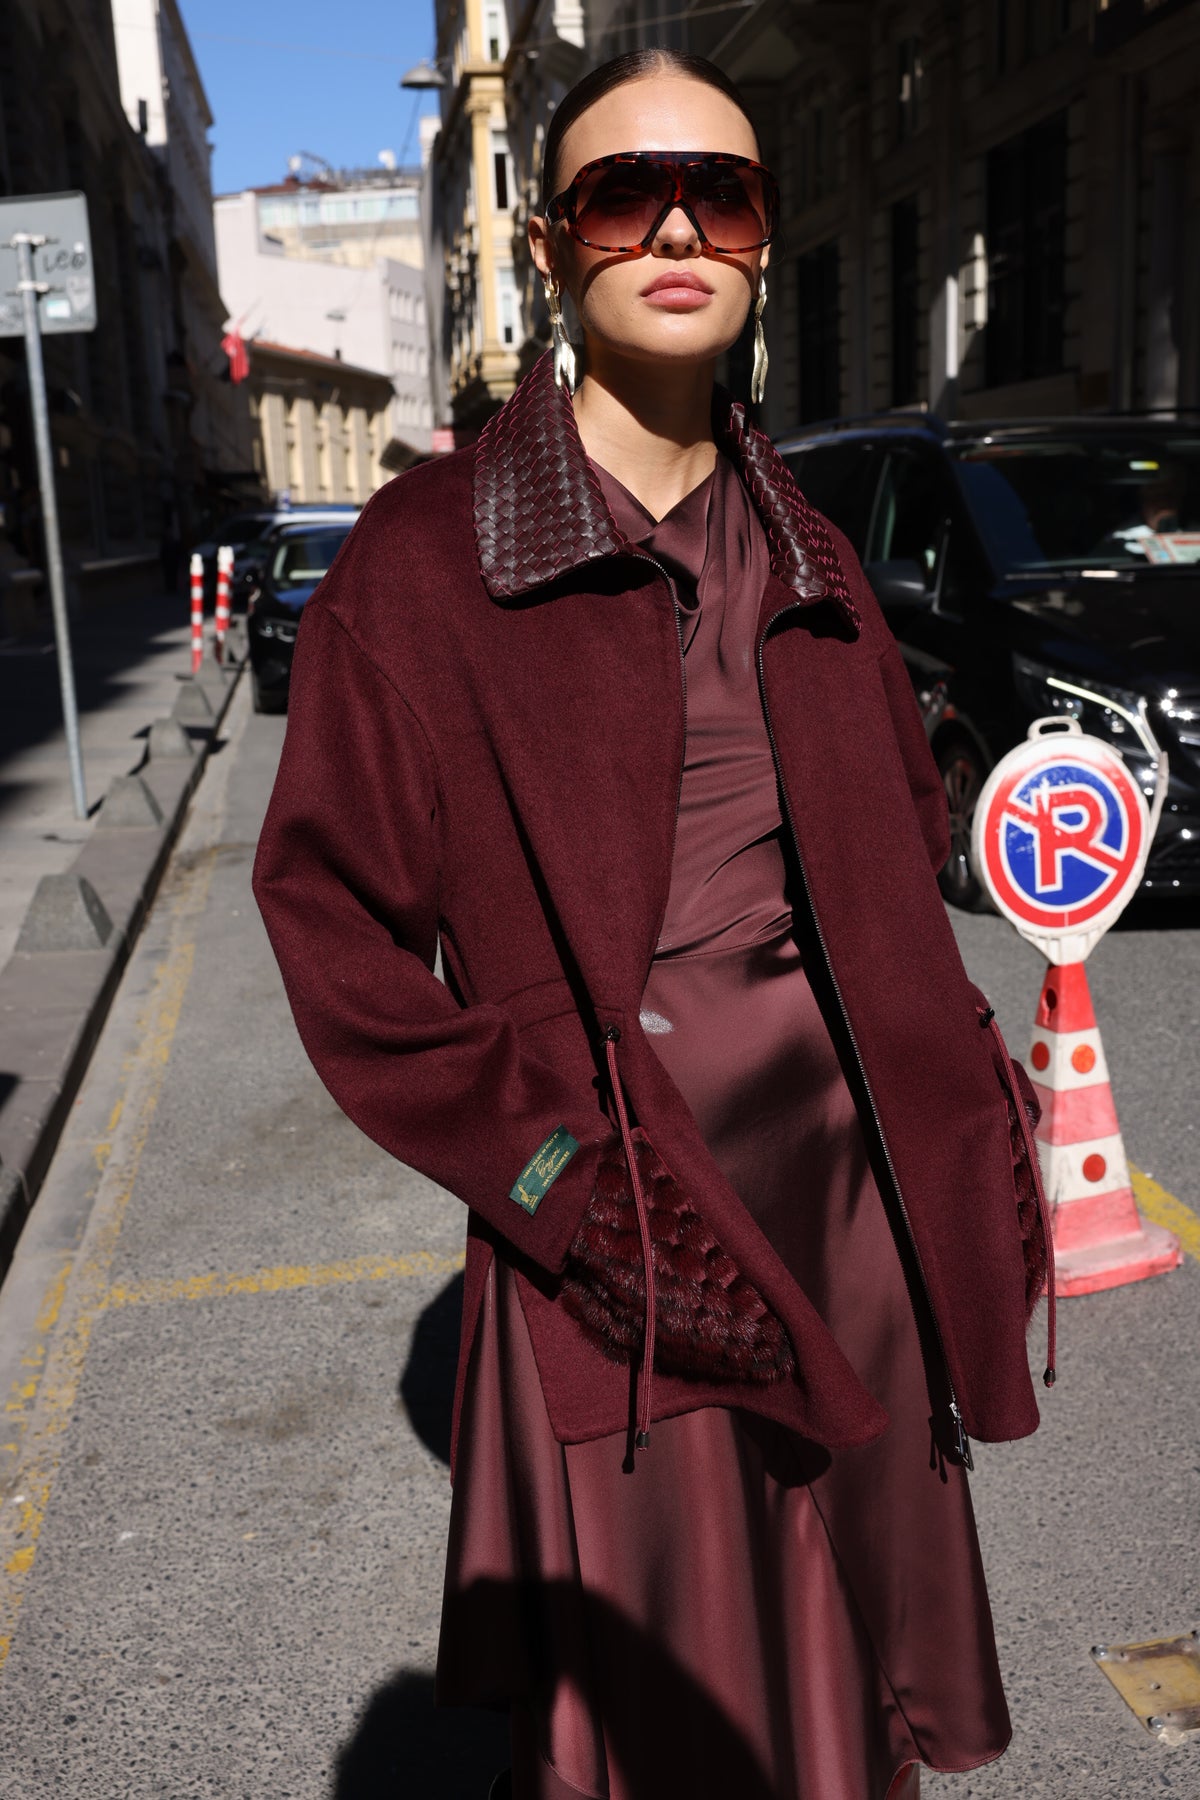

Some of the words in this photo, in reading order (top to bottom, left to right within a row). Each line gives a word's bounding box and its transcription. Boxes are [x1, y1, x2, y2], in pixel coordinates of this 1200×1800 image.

[532, 1153, 542, 1166] MADE
[545, 1138, 554, 1149] ITALY
[551, 1150, 570, 1174] CASHMERE
